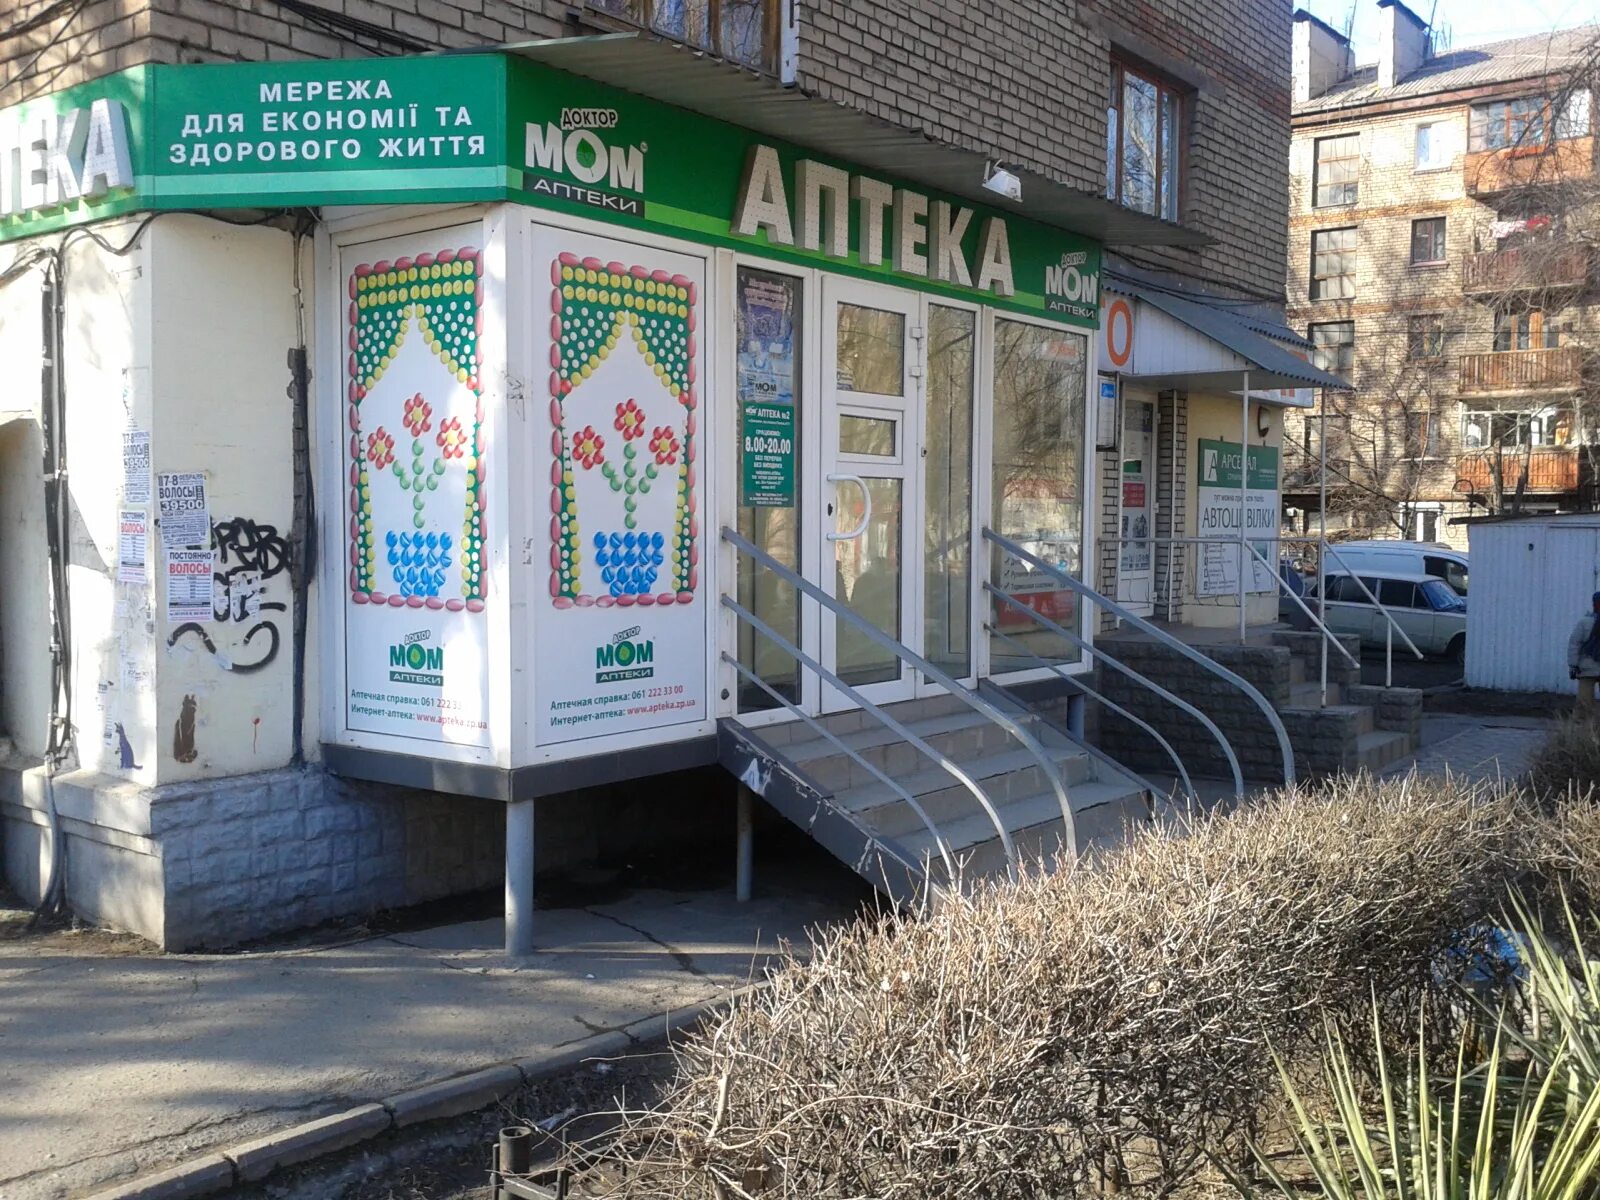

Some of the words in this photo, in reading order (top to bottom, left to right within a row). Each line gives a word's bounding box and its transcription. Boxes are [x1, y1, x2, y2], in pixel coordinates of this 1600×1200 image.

[259, 79, 393, 103] МЕРЕЖА
[181, 112, 245, 138] ДЛЯ
[262, 103, 418, 133] ЕКОНОМІЇ
[435, 105, 472, 127] ТА
[561, 107, 618, 130] ДОКТОР
[169, 138, 361, 167] ЗДОРОВОГО
[378, 135, 486, 159] ЖИТТЯ
[525, 120, 644, 194] МОМ
[533, 178, 637, 214] АПТЕКИ
[730, 143, 1016, 298] АПТЕКА
[1061, 251, 1087, 268] ДОКТОР
[1045, 263, 1097, 305] МОМ
[1049, 301, 1096, 319] АПТЕКИ
[757, 408, 781, 419] АПТЕКА
[745, 436, 791, 454] 8.00-20.00
[1221, 454, 1257, 470] АРСЕАЛ
[159, 486, 195, 498] ВОЛОСЫ
[169, 563, 212, 573] ВОЛОСЫ
[404, 630, 431, 645] ДОКТОР
[613, 626, 640, 644] ДОКТОР
[389, 643, 443, 670] МОМ
[596, 639, 654, 669] МОМ
[393, 672, 441, 684] АПТЕКИ
[600, 667, 651, 681] АПТЕКИ
[351, 688, 386, 702] Аптечная
[386, 693, 420, 705] справка:
[421, 697, 434, 707] 061
[436, 698, 451, 709] 222
[550, 697, 593, 711] Аптечная
[593, 693, 631, 706] справка:
[631, 691, 646, 700] 061
[648, 688, 662, 698] 222
[664, 687, 673, 695] 33
[674, 685, 684, 694] 00
[351, 704, 416, 720] Интернет-аптека:
[550, 708, 626, 726] Интернет-аптека:
[627, 699, 696, 716] www.apteka.zp.ua
